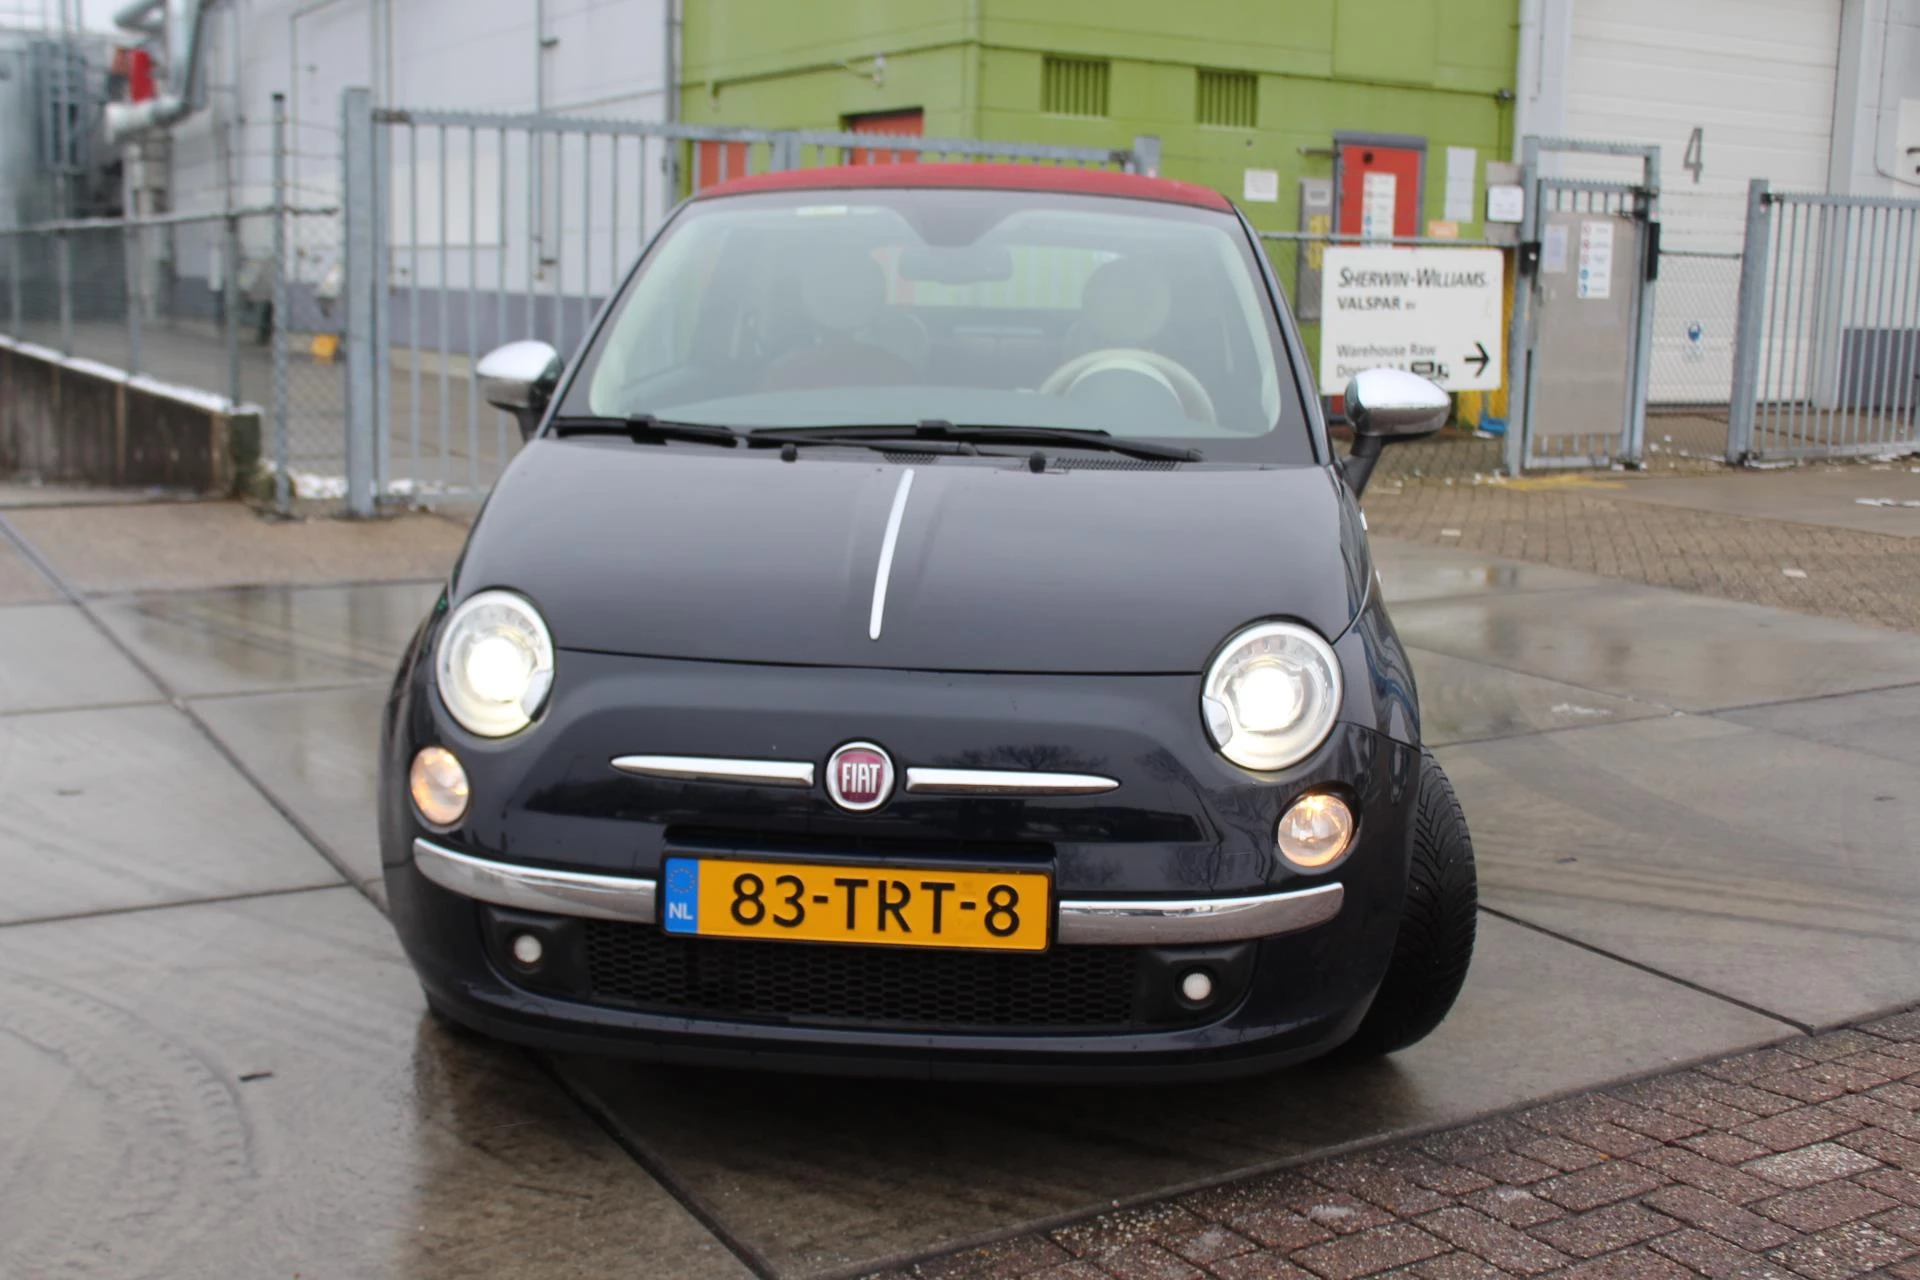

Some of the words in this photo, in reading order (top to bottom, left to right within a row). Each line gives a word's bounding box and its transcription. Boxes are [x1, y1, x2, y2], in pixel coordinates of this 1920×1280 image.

[1683, 127, 1704, 184] 4
[1336, 296, 1401, 311] VALSPAR
[1336, 343, 1406, 357] Warehouse
[841, 762, 881, 793] FIAT
[668, 902, 694, 920] NL
[730, 873, 1020, 936] 83-TRT-8
